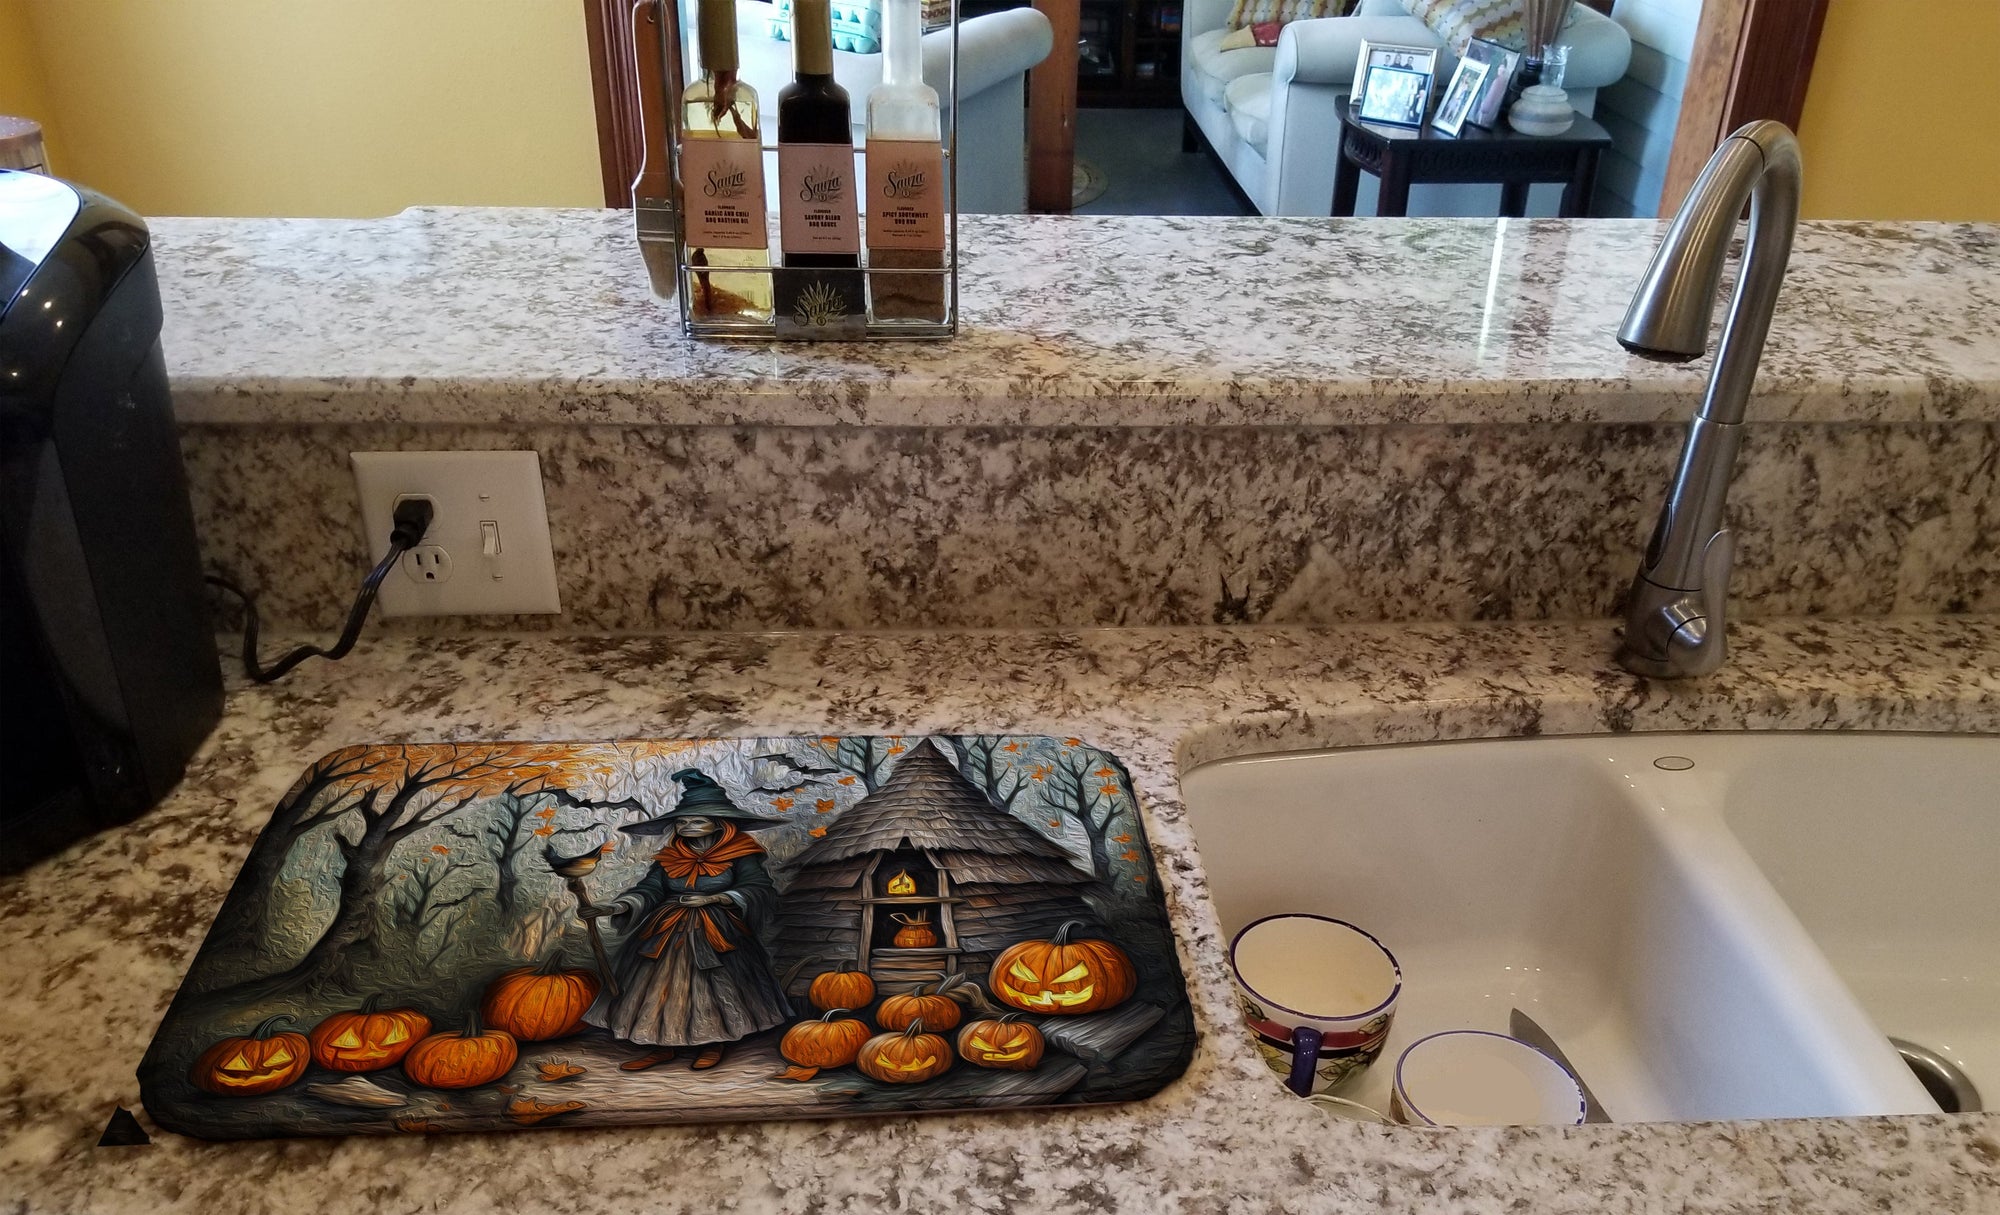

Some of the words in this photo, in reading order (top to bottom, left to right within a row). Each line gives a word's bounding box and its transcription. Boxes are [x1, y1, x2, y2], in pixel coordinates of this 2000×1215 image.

[703, 170, 746, 197] Sauza
[800, 175, 842, 202] Sauza
[884, 171, 926, 198] Sauza
